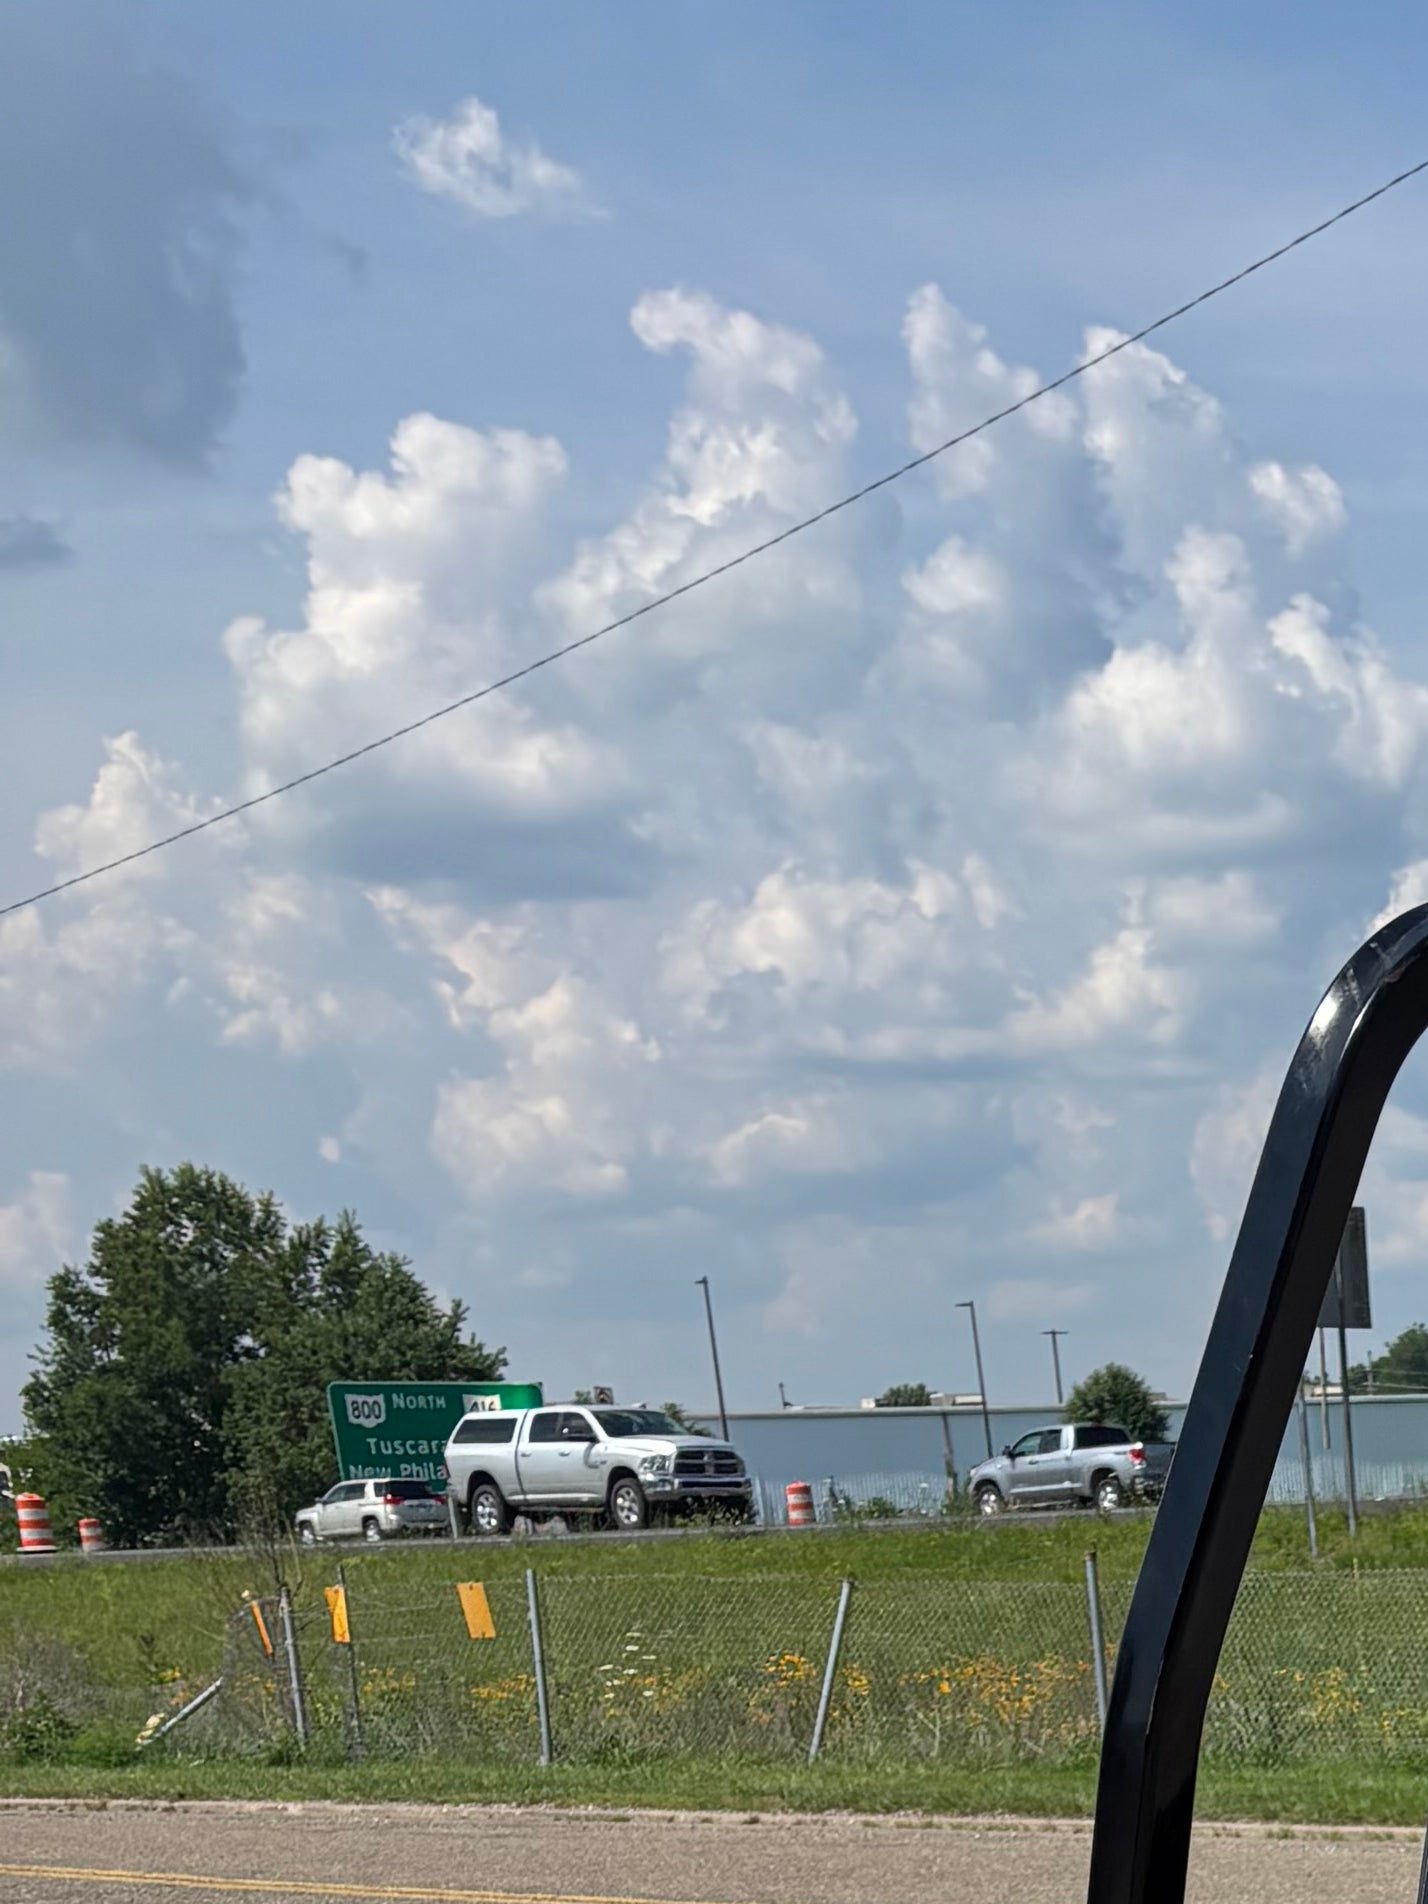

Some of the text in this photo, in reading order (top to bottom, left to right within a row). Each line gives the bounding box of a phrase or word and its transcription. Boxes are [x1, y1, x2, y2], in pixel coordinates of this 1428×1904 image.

[351, 1400, 382, 1420] 800
[392, 1393, 446, 1410] NORTH
[350, 1464, 391, 1479] New
